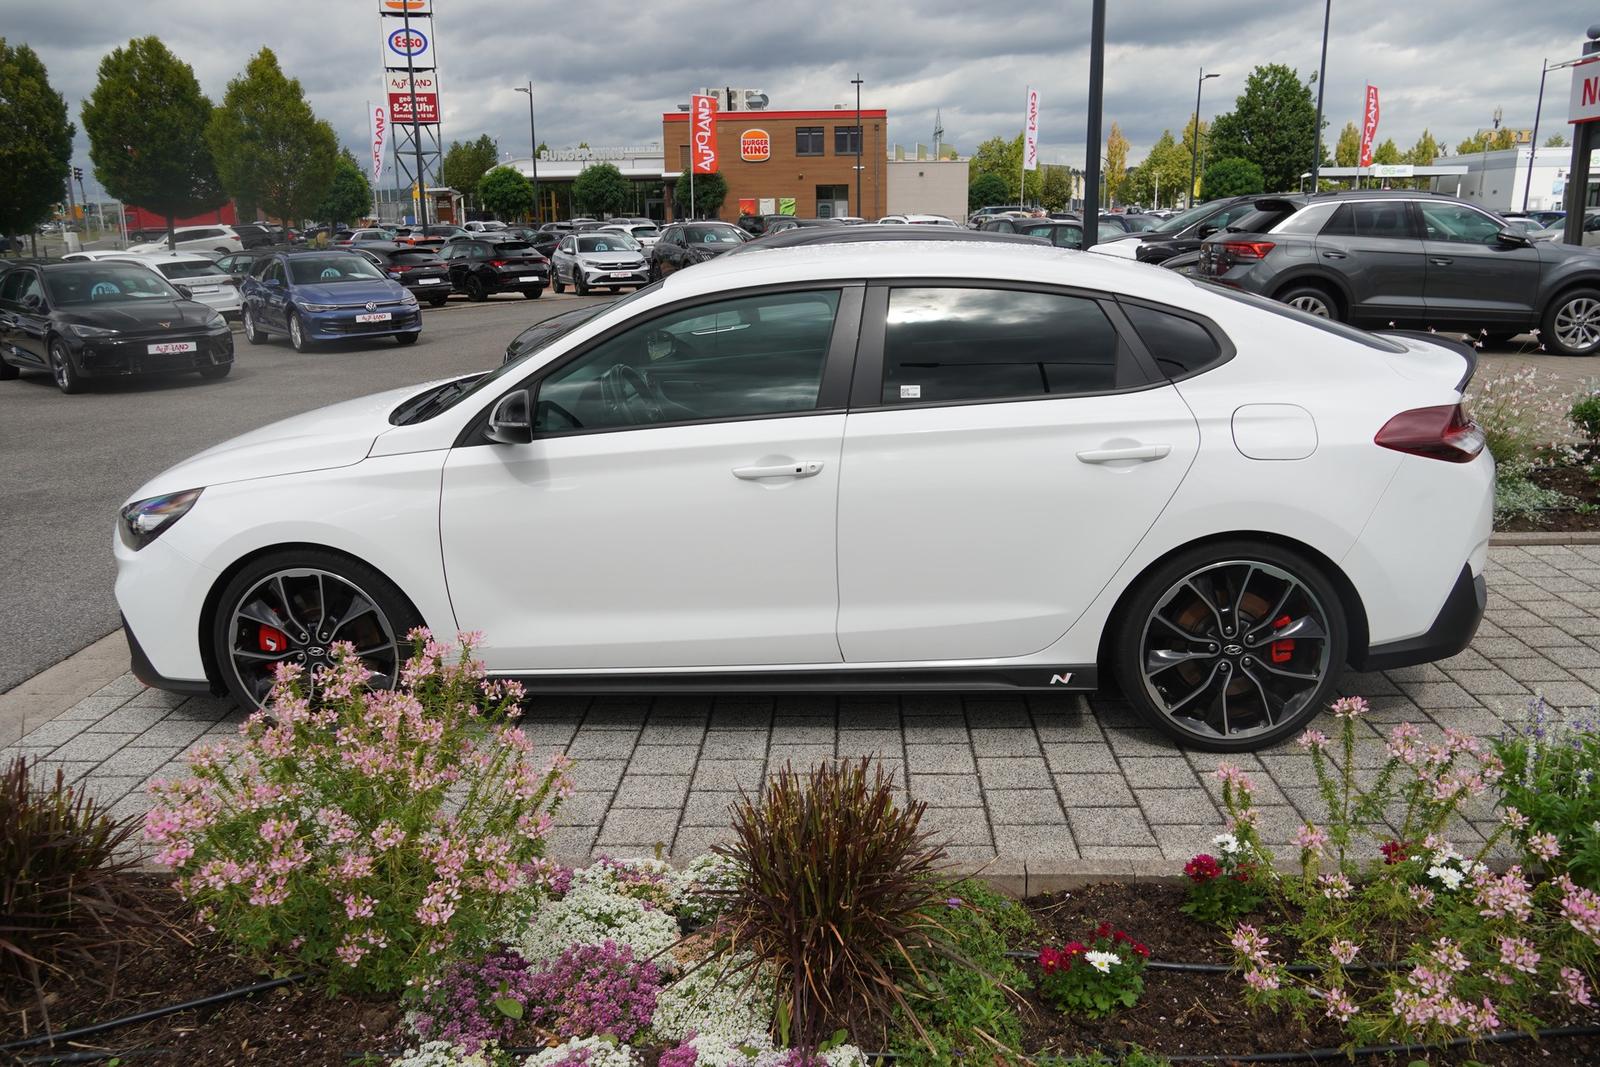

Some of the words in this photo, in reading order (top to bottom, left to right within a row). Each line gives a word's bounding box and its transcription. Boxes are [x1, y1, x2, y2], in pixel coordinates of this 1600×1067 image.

[394, 36, 422, 48] Esso
[391, 79, 432, 89] AUTAND
[1581, 76, 1600, 107] N
[398, 95, 428, 104] geönet
[415, 103, 434, 112] Uhr
[696, 97, 715, 171] AUTOLAND
[742, 145, 769, 155] KING
